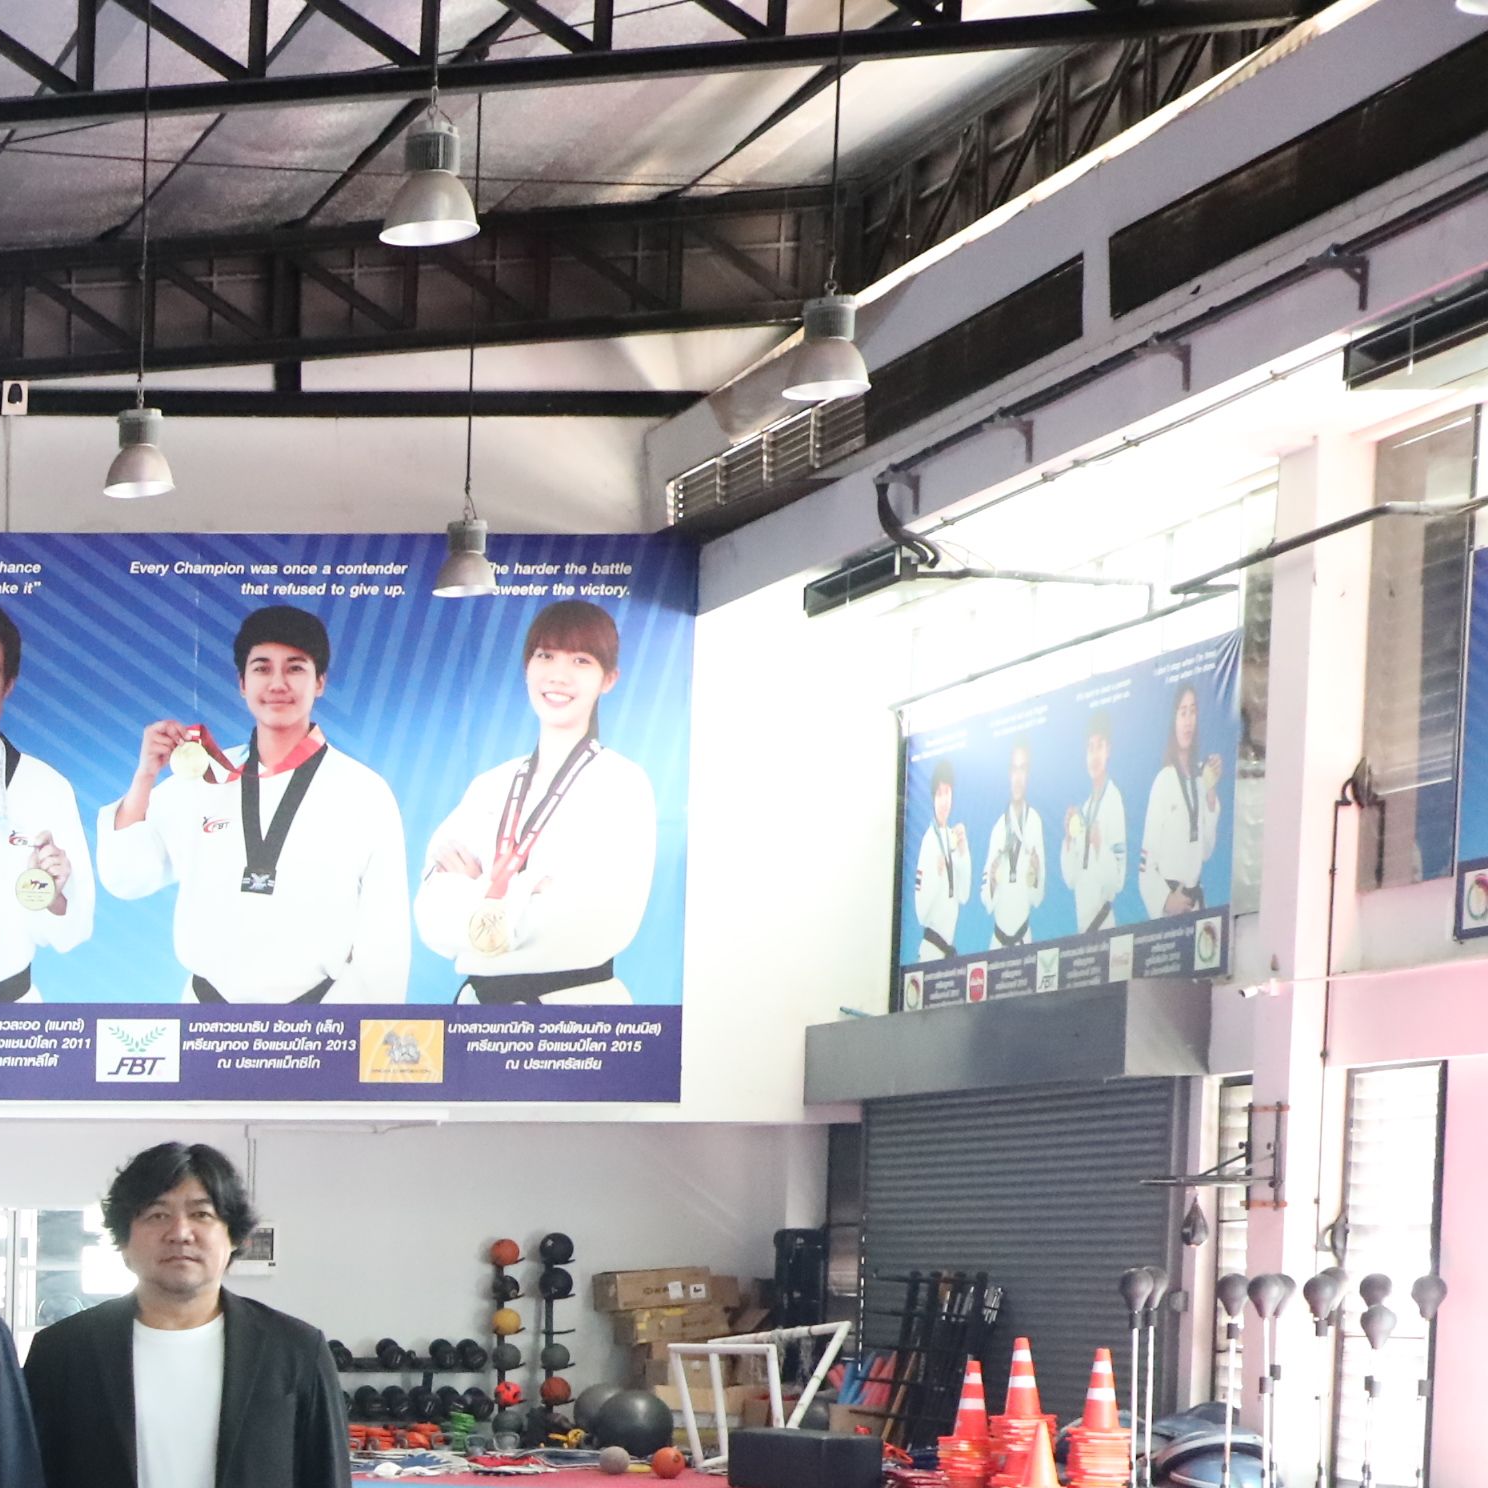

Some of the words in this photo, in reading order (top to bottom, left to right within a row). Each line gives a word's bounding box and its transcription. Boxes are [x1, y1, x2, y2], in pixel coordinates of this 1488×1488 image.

[130, 561, 169, 577] Every
[174, 561, 245, 577] Champion
[250, 565, 278, 574] was
[283, 565, 318, 575] once
[322, 565, 331, 575] a
[336, 562, 408, 575] contender
[513, 562, 561, 575] harder
[565, 563, 587, 575] the
[592, 562, 632, 575] battle
[23, 581, 41, 594] it”
[241, 583, 269, 595] that
[273, 583, 326, 595] refused
[331, 583, 345, 596] to
[349, 583, 380, 598] give
[384, 585, 405, 598] up.
[492, 583, 549, 596] sweeter
[552, 583, 575, 596] the
[580, 583, 630, 598] victory.
[182, 1037, 249, 1052] เหรียญทอง
[325, 1039, 356, 1051] 2013
[467, 1038, 534, 1054] เหรียญทอง
[610, 1040, 642, 1052] 2015
[107, 1056, 166, 1076] FBT
[217, 1058, 232, 1069] ณ
[505, 1059, 520, 1070] ณ
